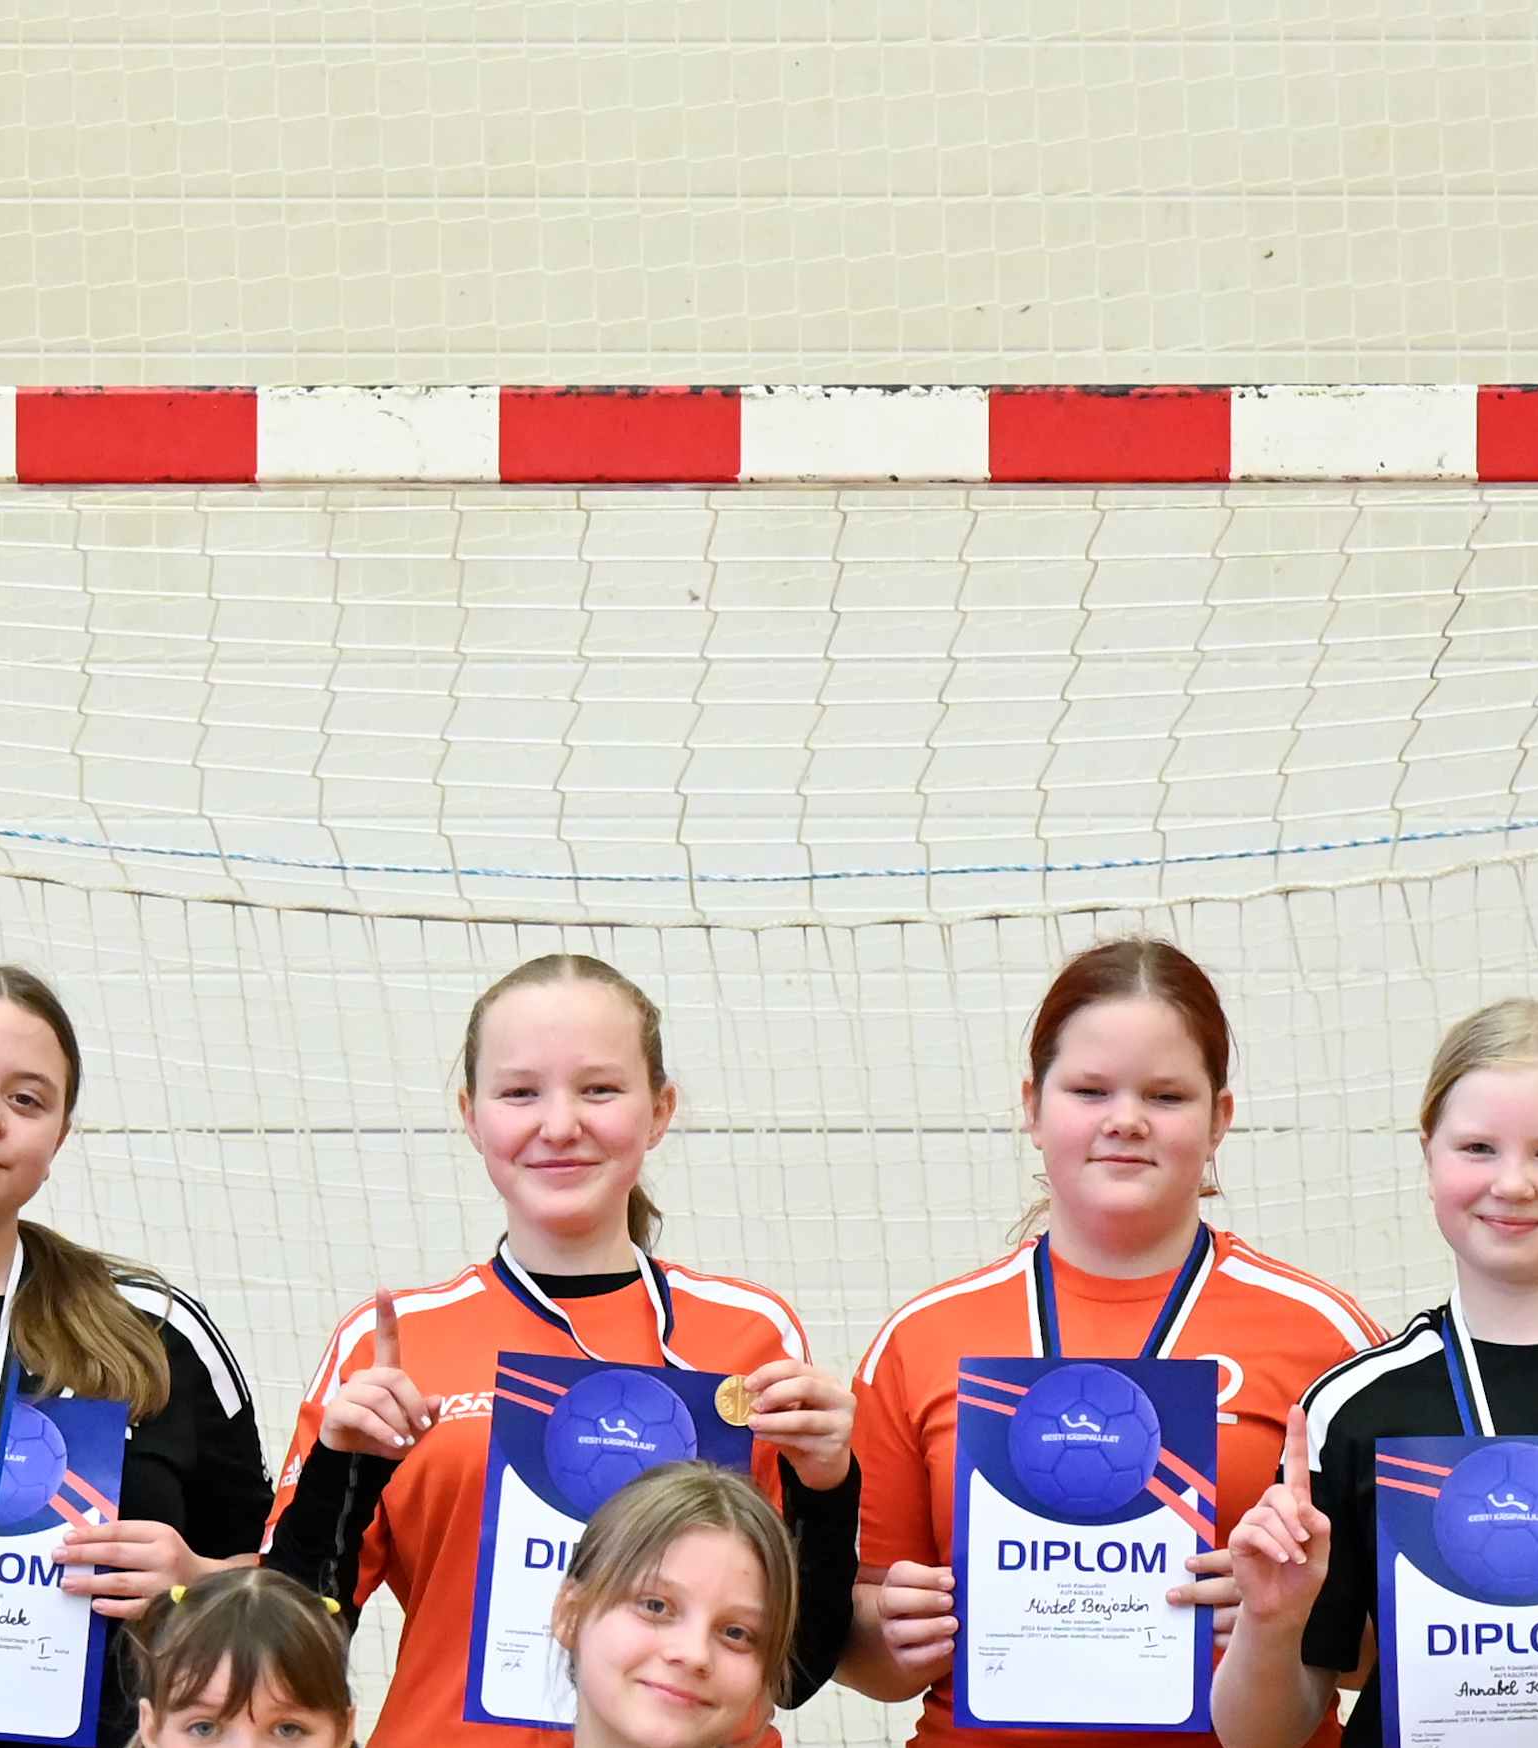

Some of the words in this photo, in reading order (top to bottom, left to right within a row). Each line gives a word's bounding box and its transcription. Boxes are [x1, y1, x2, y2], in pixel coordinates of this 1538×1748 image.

[440, 1391, 495, 1417] VSK
[999, 1540, 1167, 1574] DIPLOM
[1024, 1597, 1076, 1615] Mirtel
[1454, 1680, 1518, 1697] Annabel
